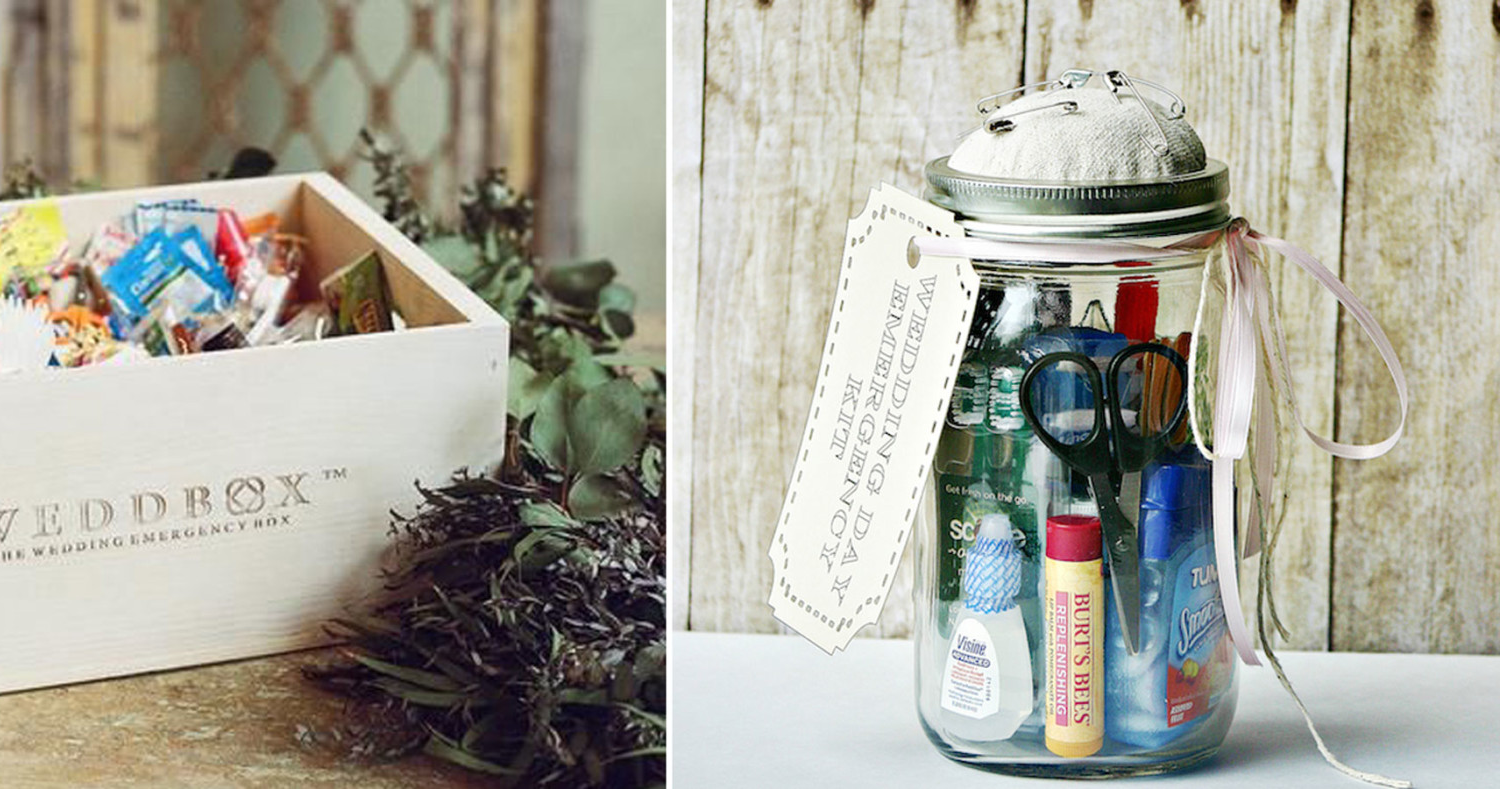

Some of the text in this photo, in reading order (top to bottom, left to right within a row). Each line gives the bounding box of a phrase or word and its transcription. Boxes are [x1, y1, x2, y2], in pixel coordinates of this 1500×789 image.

[820, 278, 911, 573] EMERGENCY
[829, 373, 863, 461] KIT
[832, 274, 937, 606] WEDDING DAY
[945, 484, 960, 494] Get
[984, 492, 996, 500] on
[997, 492, 1012, 503] the
[1014, 496, 1026, 505] go
[32, 537, 124, 557] WEDDING
[129, 522, 246, 546] EMERGENCY
[253, 514, 291, 528] BOX
[949, 519, 1027, 548] sce
[1191, 564, 1219, 589] TUM
[952, 650, 989, 667] ADVANCED
[957, 634, 987, 656] Visine
[1056, 604, 1067, 715] REPLENISHING
[1073, 592, 1090, 724] BURT'S BEES
